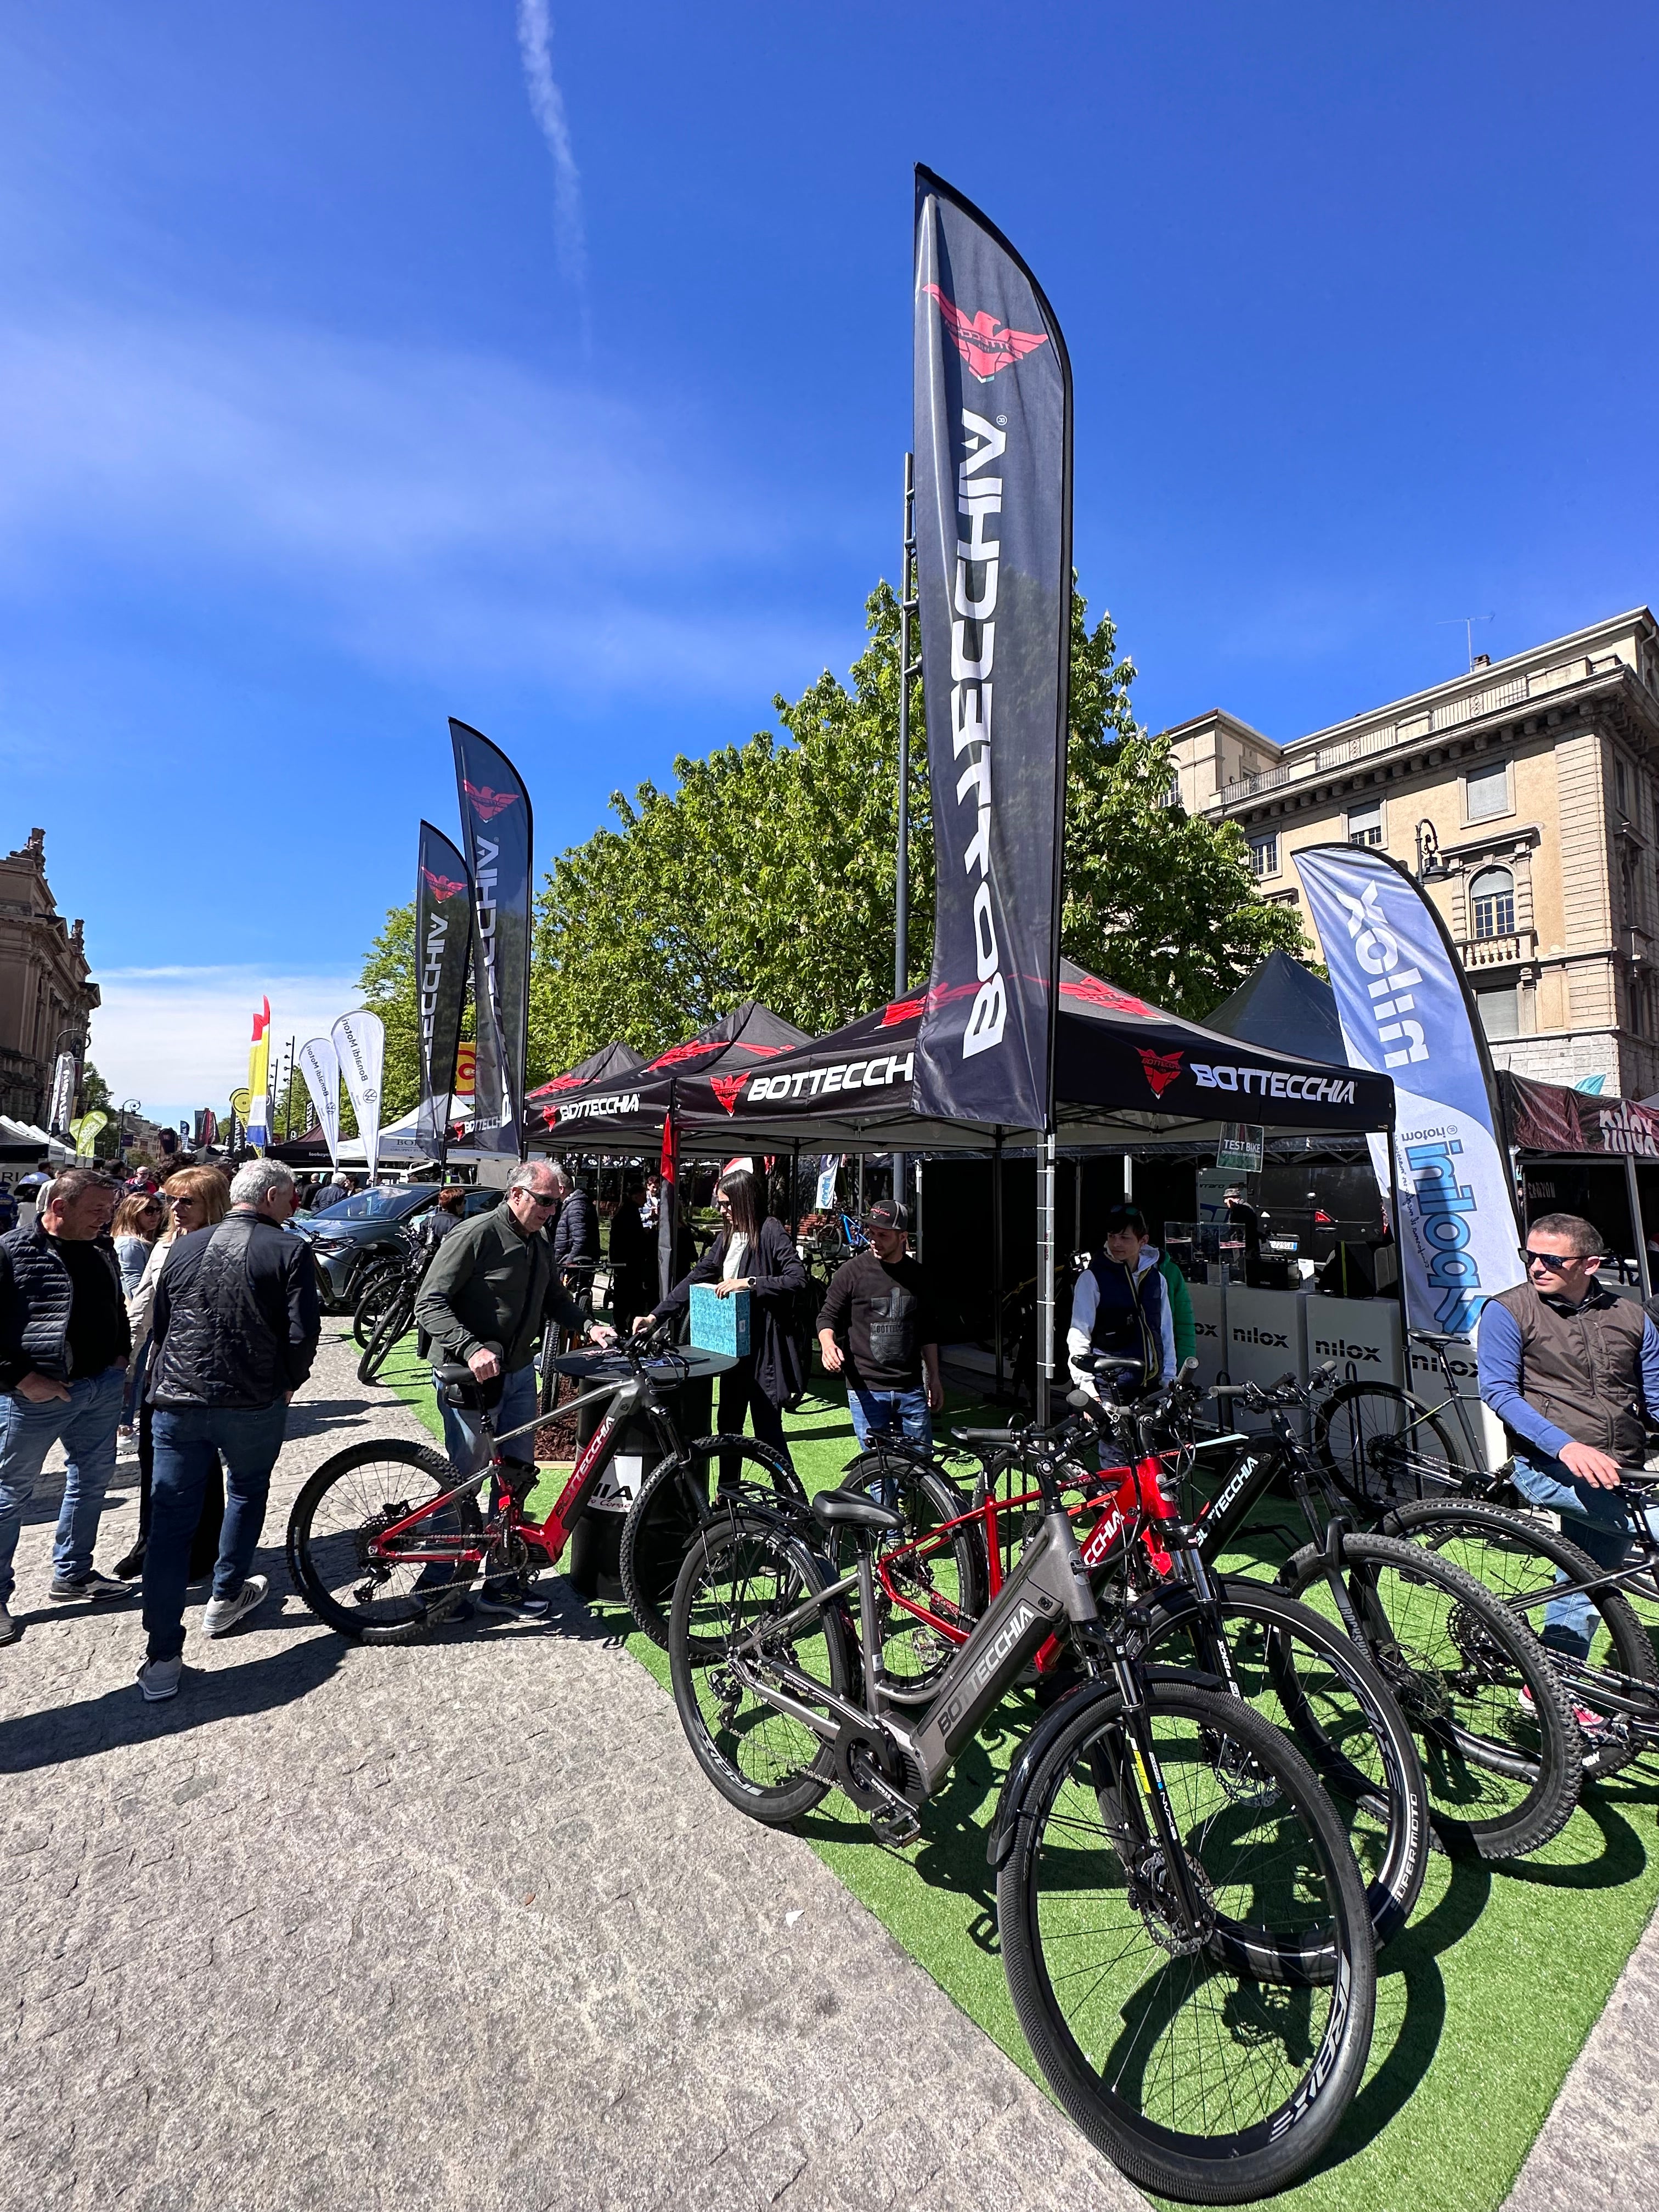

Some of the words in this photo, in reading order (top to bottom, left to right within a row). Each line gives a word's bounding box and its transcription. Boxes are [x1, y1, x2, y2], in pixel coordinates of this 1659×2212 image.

[1189, 1063, 1355, 1104] BOTTECCHIA
[560, 1093, 640, 1121] BOTTECCHIA
[1223, 1139, 1245, 1151] TEST
[1246, 1142, 1261, 1153] BIKE
[1194, 1322, 1218, 1338] ox
[1233, 1327, 1290, 1349] nilox
[1315, 1339, 1383, 1363] nilox
[1412, 1353, 1479, 1378] niox
[555, 1415, 616, 1518] BOTTECCHIA
[936, 1604, 1036, 1738] BOTTECCHIA
